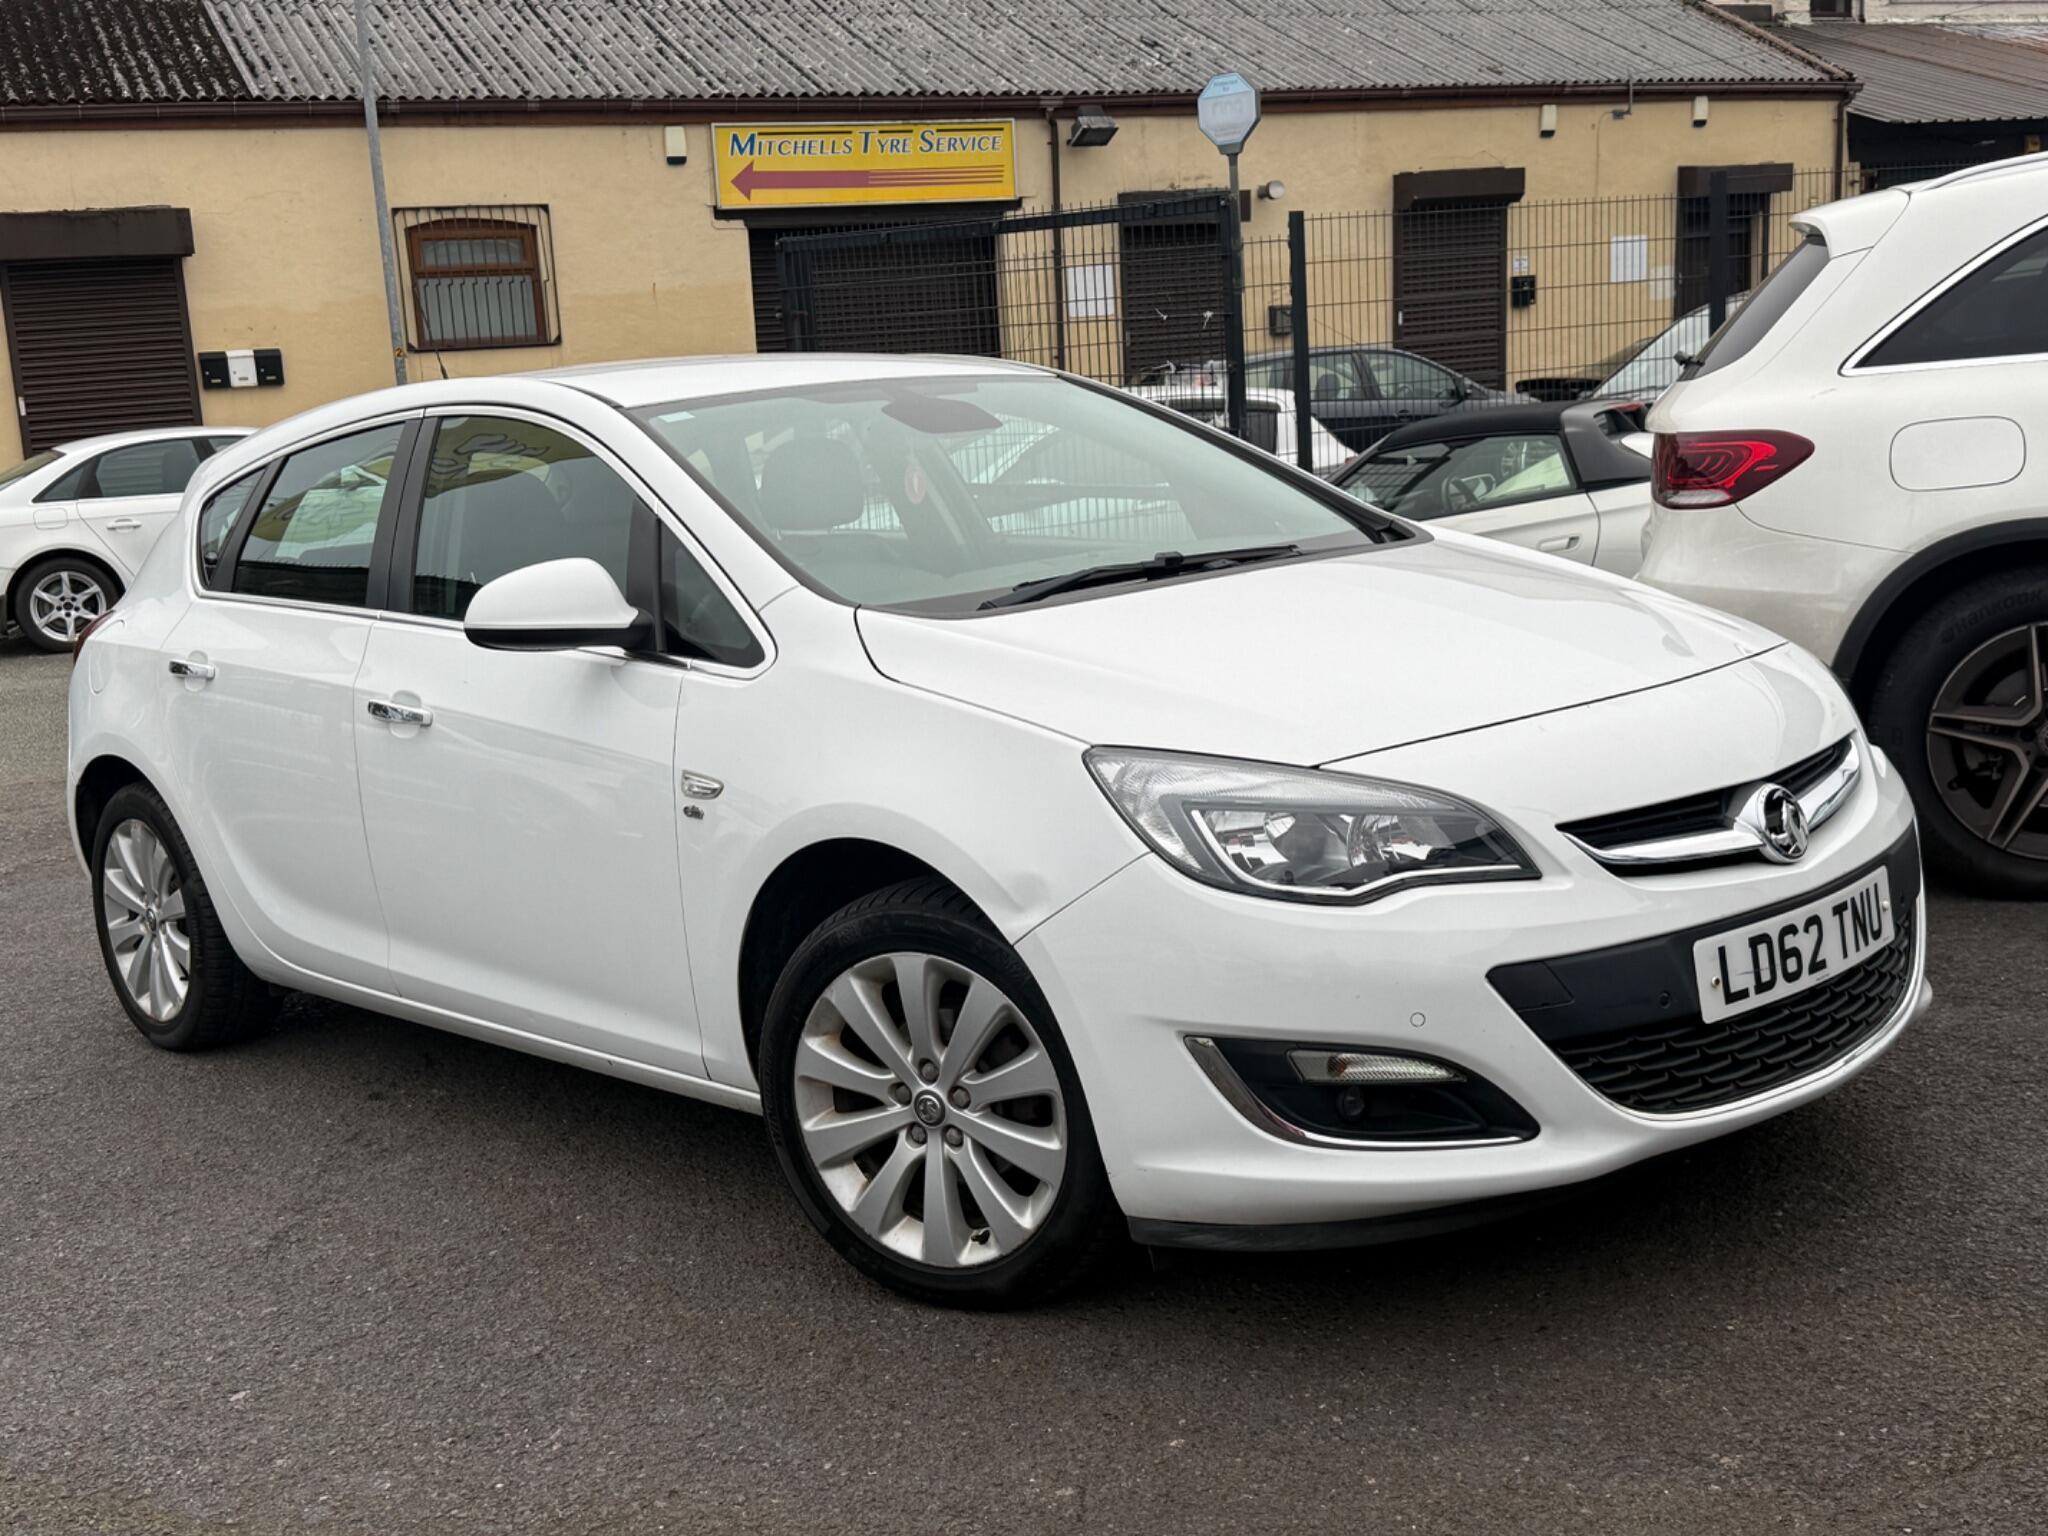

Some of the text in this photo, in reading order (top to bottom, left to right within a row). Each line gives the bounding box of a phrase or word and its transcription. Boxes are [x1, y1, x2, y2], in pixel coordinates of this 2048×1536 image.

[730, 129, 1002, 157] MITCHELLS TYRE SERVICE
[1718, 883, 1883, 1006] LD62 TNU
